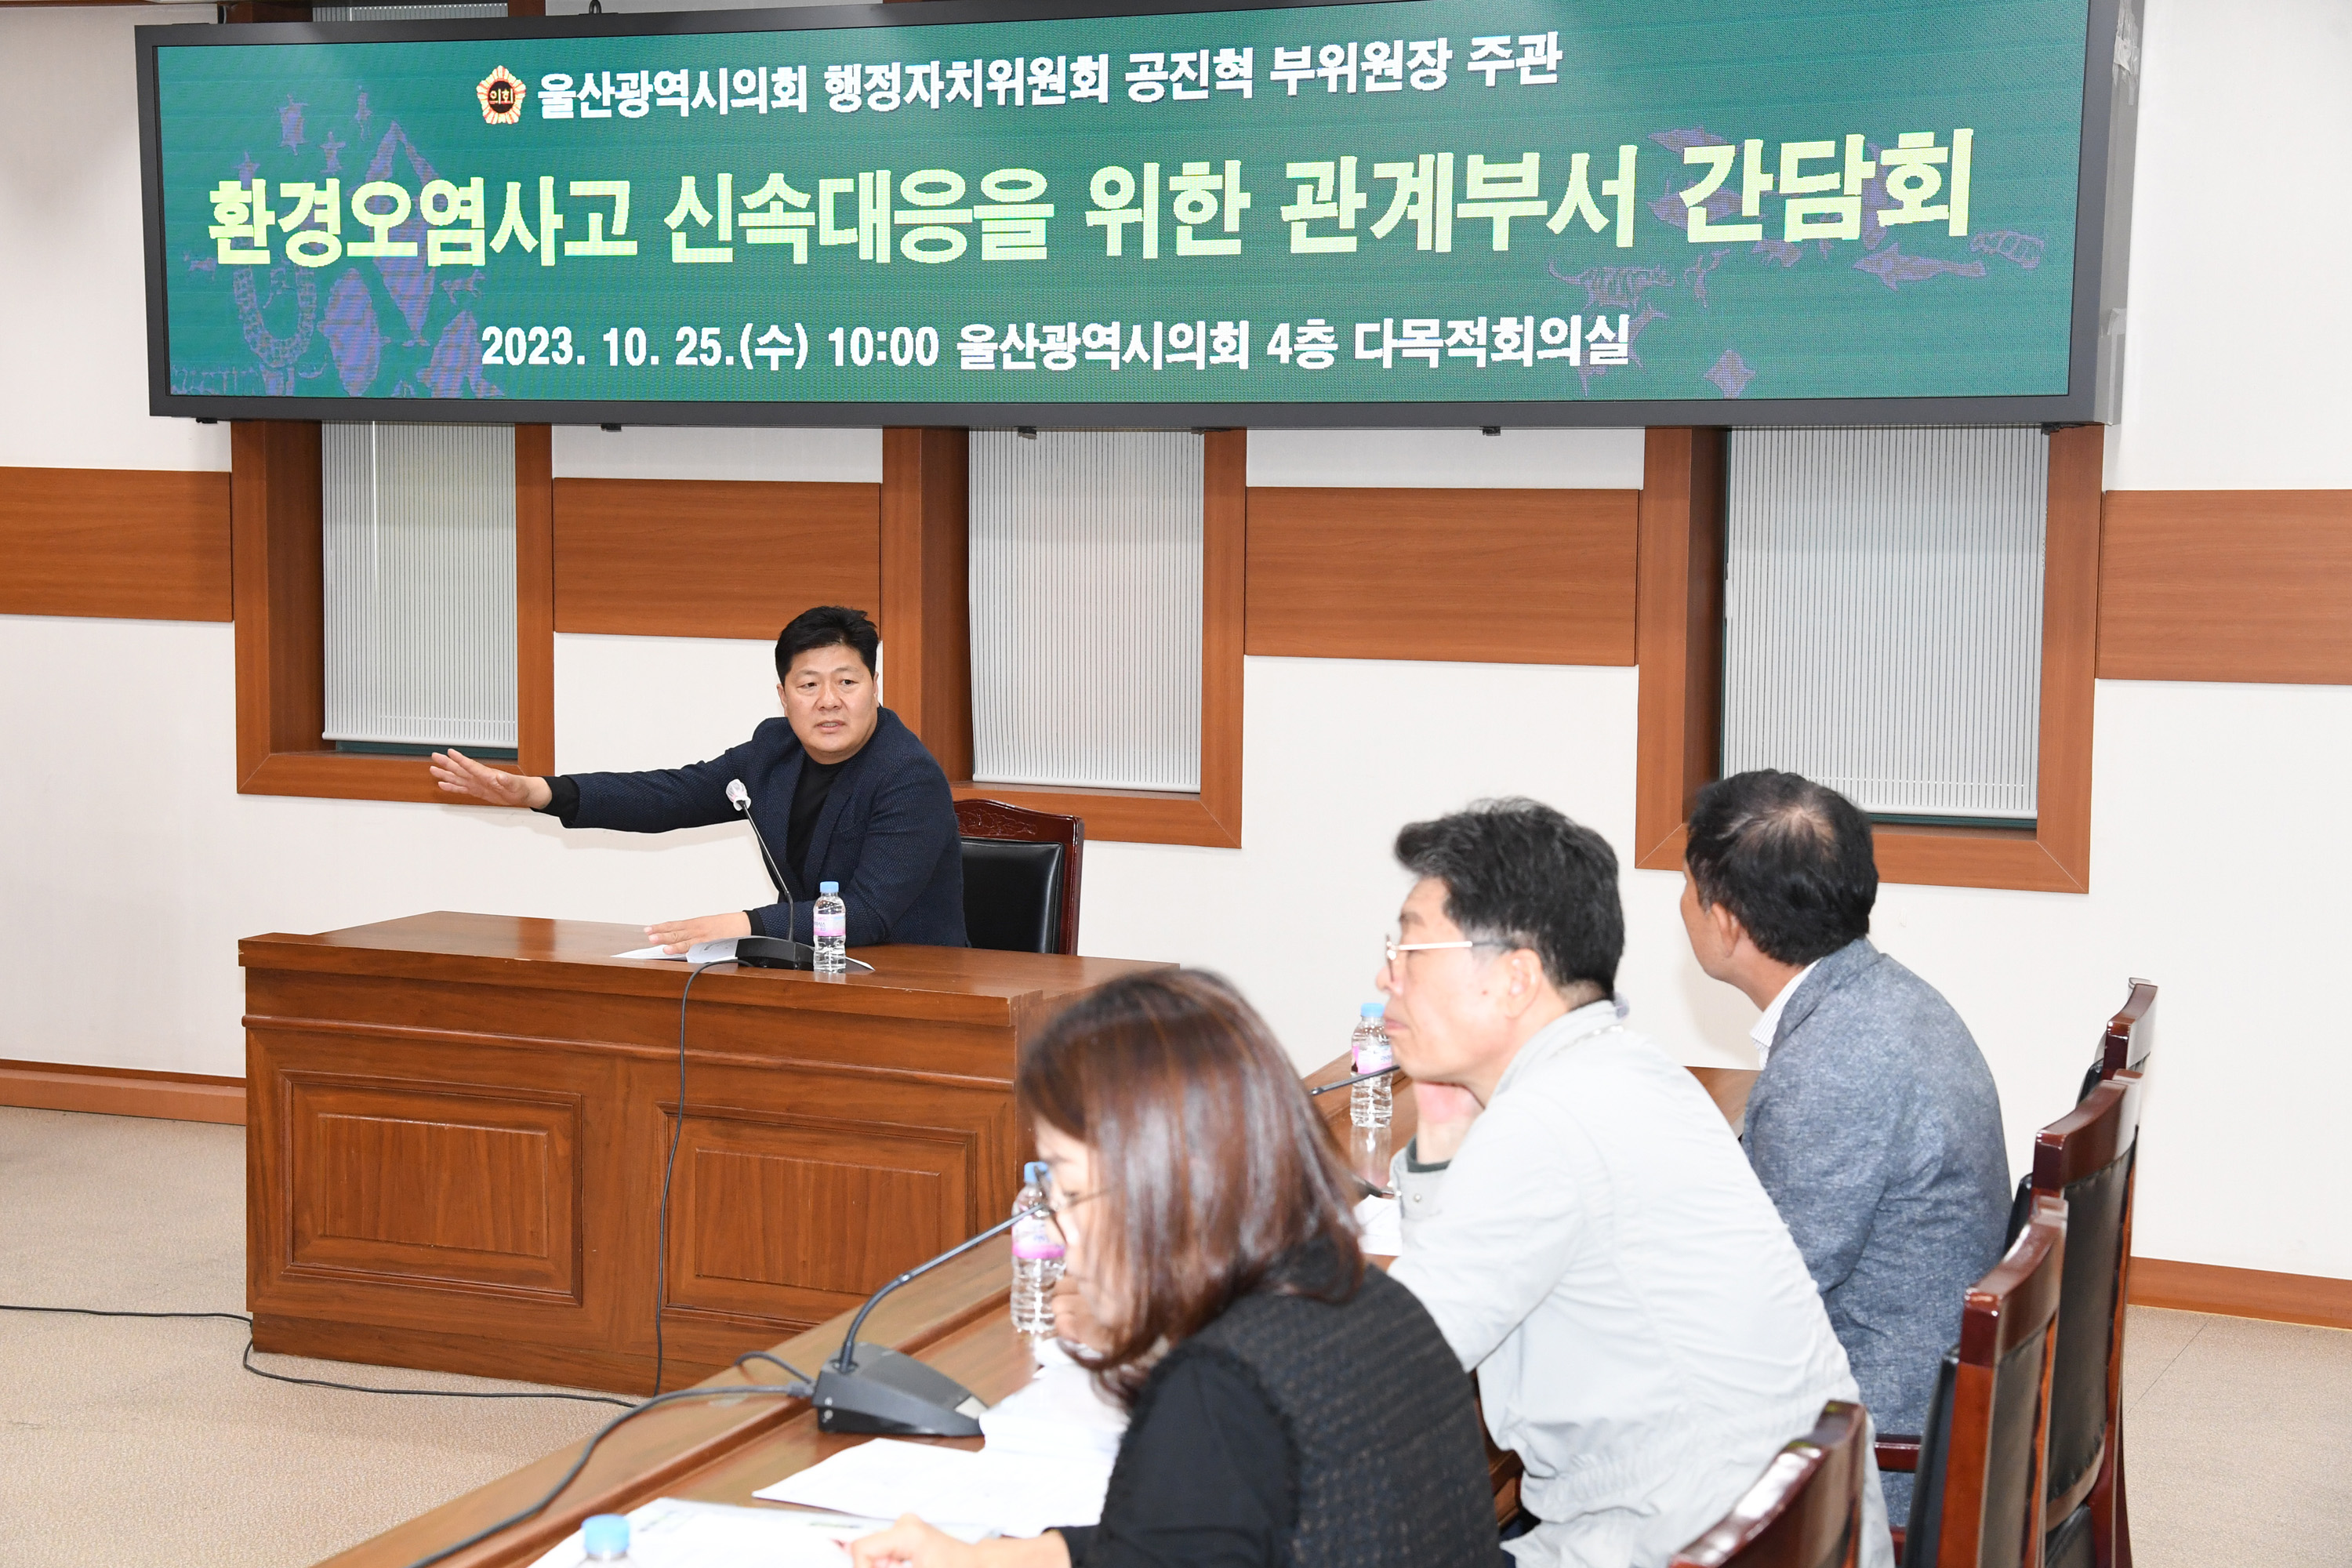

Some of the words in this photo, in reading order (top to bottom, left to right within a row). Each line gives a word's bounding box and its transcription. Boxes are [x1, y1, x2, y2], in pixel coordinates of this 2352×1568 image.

[489, 88, 514, 104] 의회
[539, 66, 807, 118] 울산광역시의회
[825, 55, 1108, 111] 행정자치위원회
[1126, 48, 1253, 102] 공진혁
[1271, 38, 1452, 95] 부위원장
[1468, 31, 1563, 86] 주관
[209, 176, 637, 267] 환경오염사고
[664, 169, 1054, 263] 신속대응을
[1085, 160, 1250, 259] 위한
[1280, 145, 1638, 253] 관계부서
[1679, 129, 1973, 242] 간담회
[482, 327, 585, 365] 2023.
[604, 328, 659, 365] 10.
[676, 323, 808, 370] 25.(수)
[829, 327, 938, 366] 10:00
[957, 321, 1249, 370] 울산광역시의회
[1267, 319, 1338, 369] 4층
[1355, 314, 1629, 368] 다목적회의실
